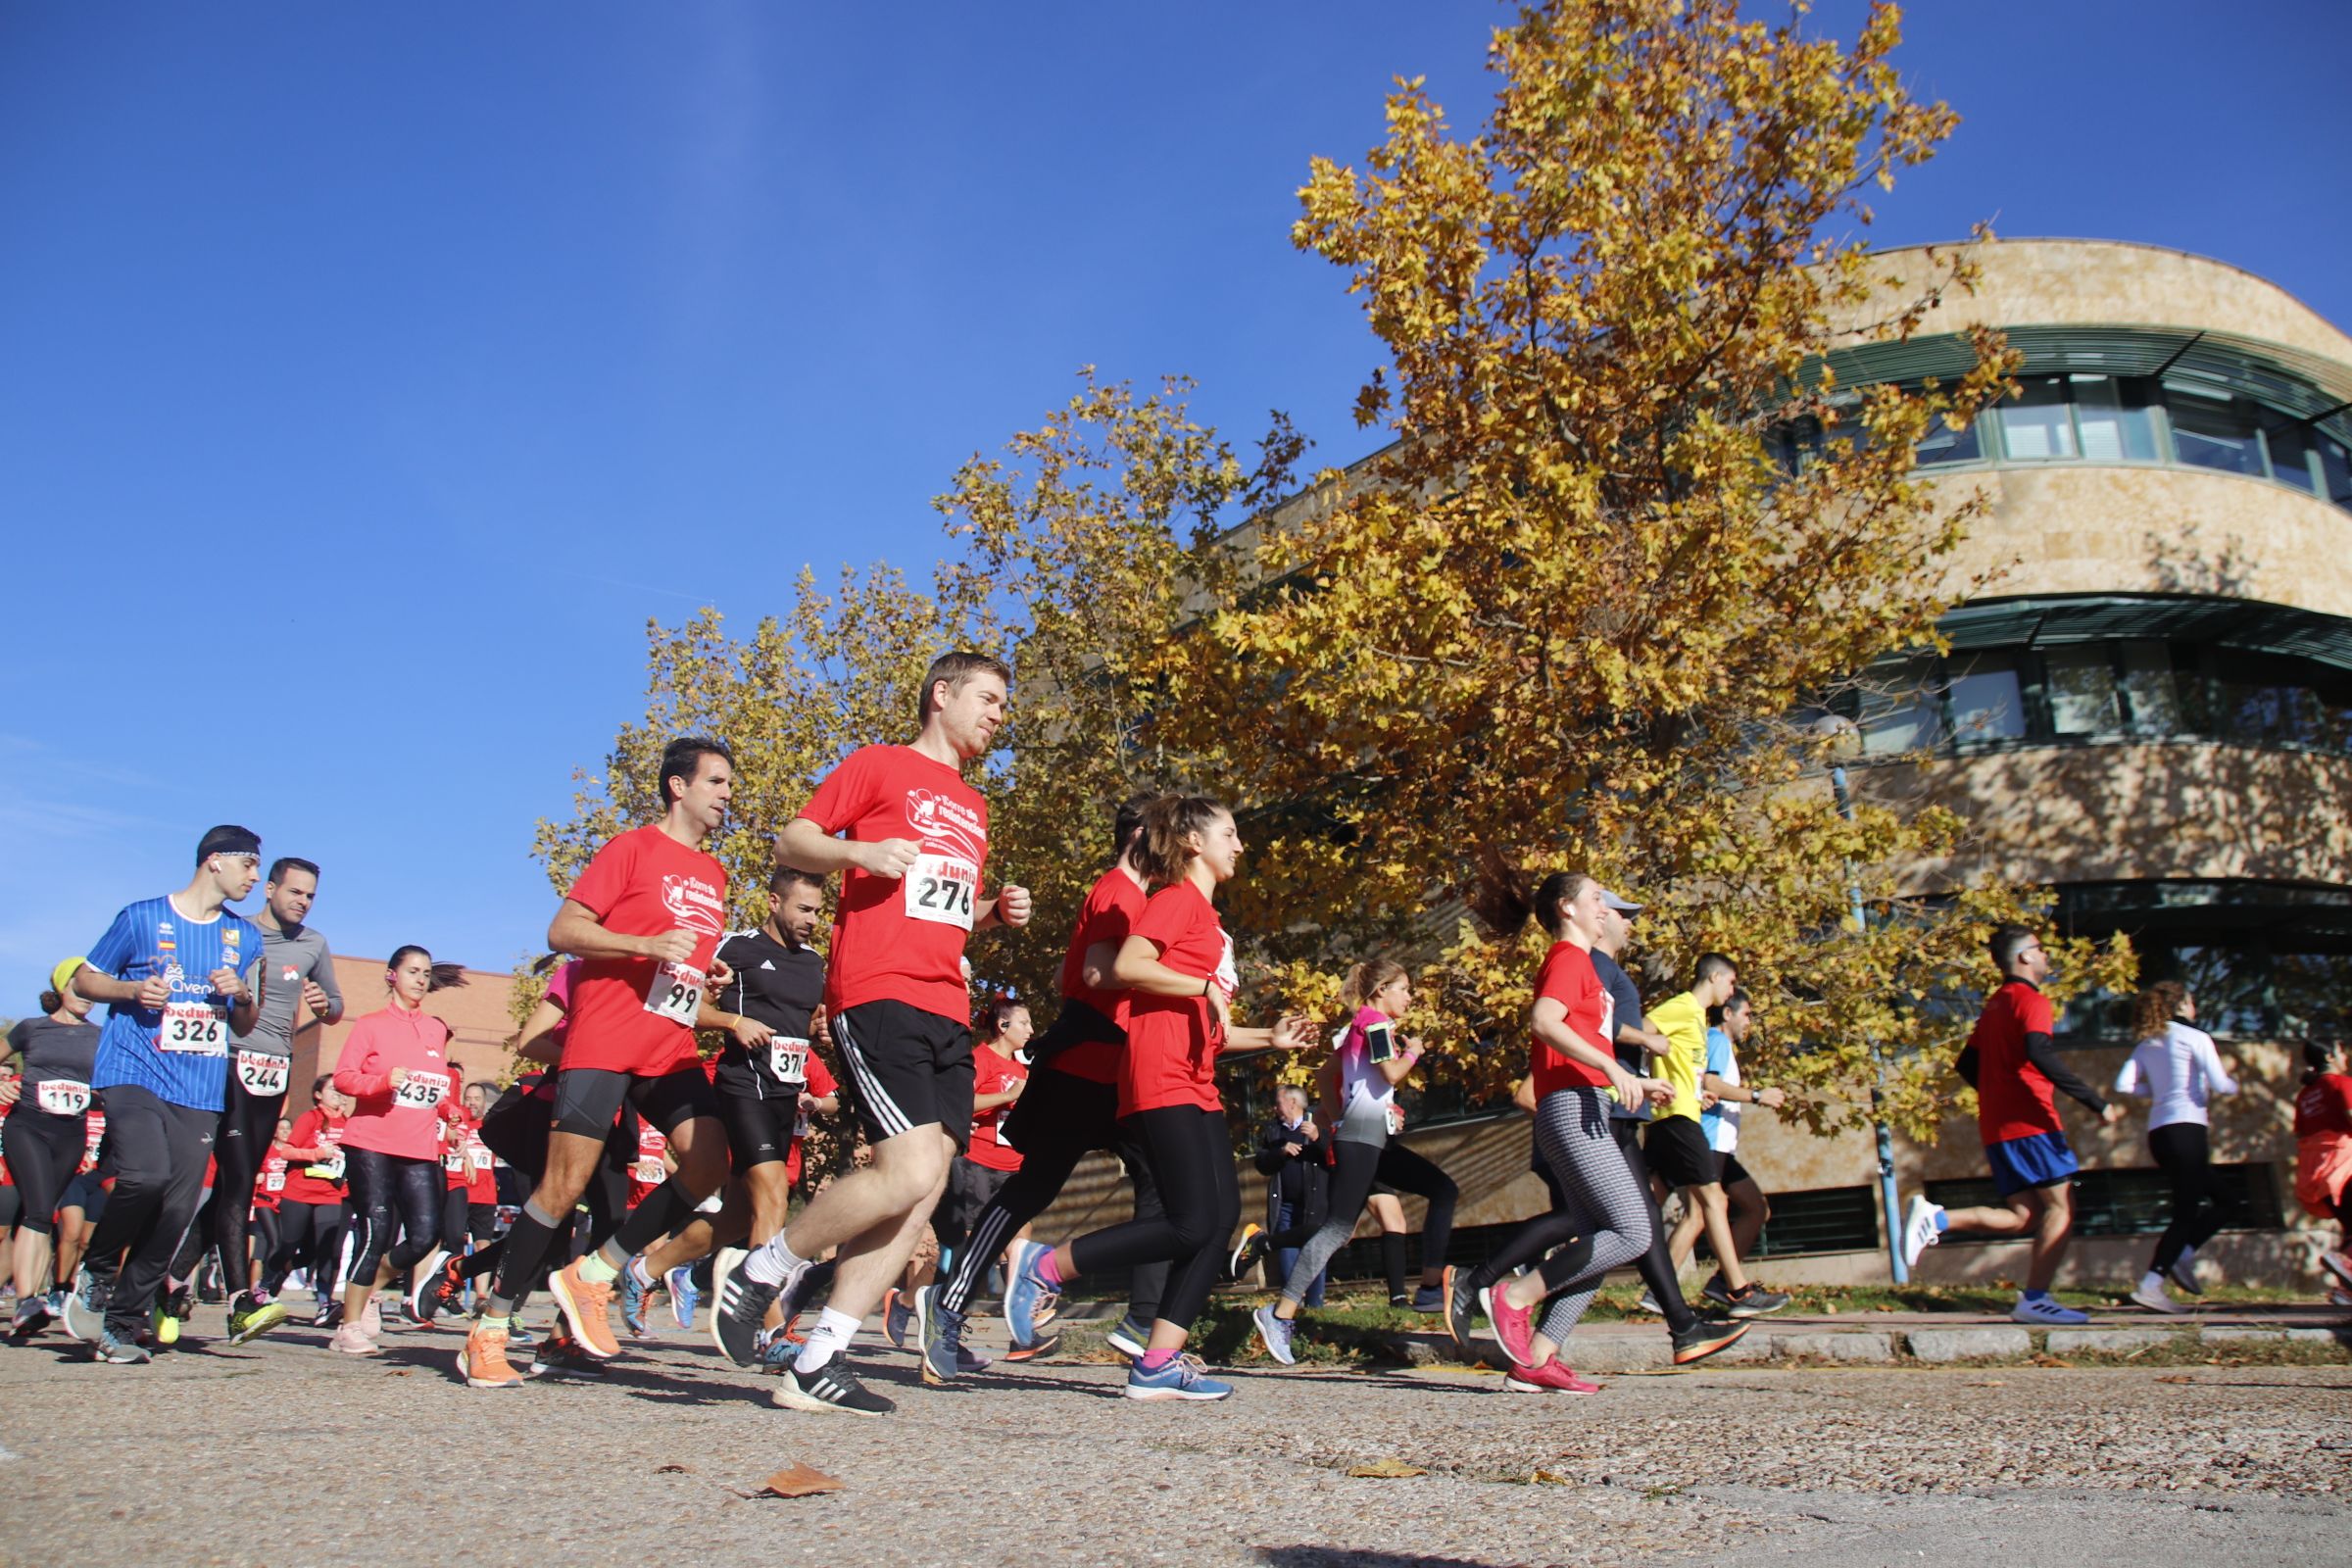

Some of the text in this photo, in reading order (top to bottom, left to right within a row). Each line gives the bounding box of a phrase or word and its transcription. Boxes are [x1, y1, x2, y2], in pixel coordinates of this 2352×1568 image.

[918, 876, 970, 916] 276
[669, 983, 698, 1013] 99
[172, 1019, 219, 1043] 326
[244, 1066, 279, 1090] 244
[407, 1073, 449, 1088] edunia
[49, 1091, 84, 1109] 119
[400, 1082, 440, 1104] 435
